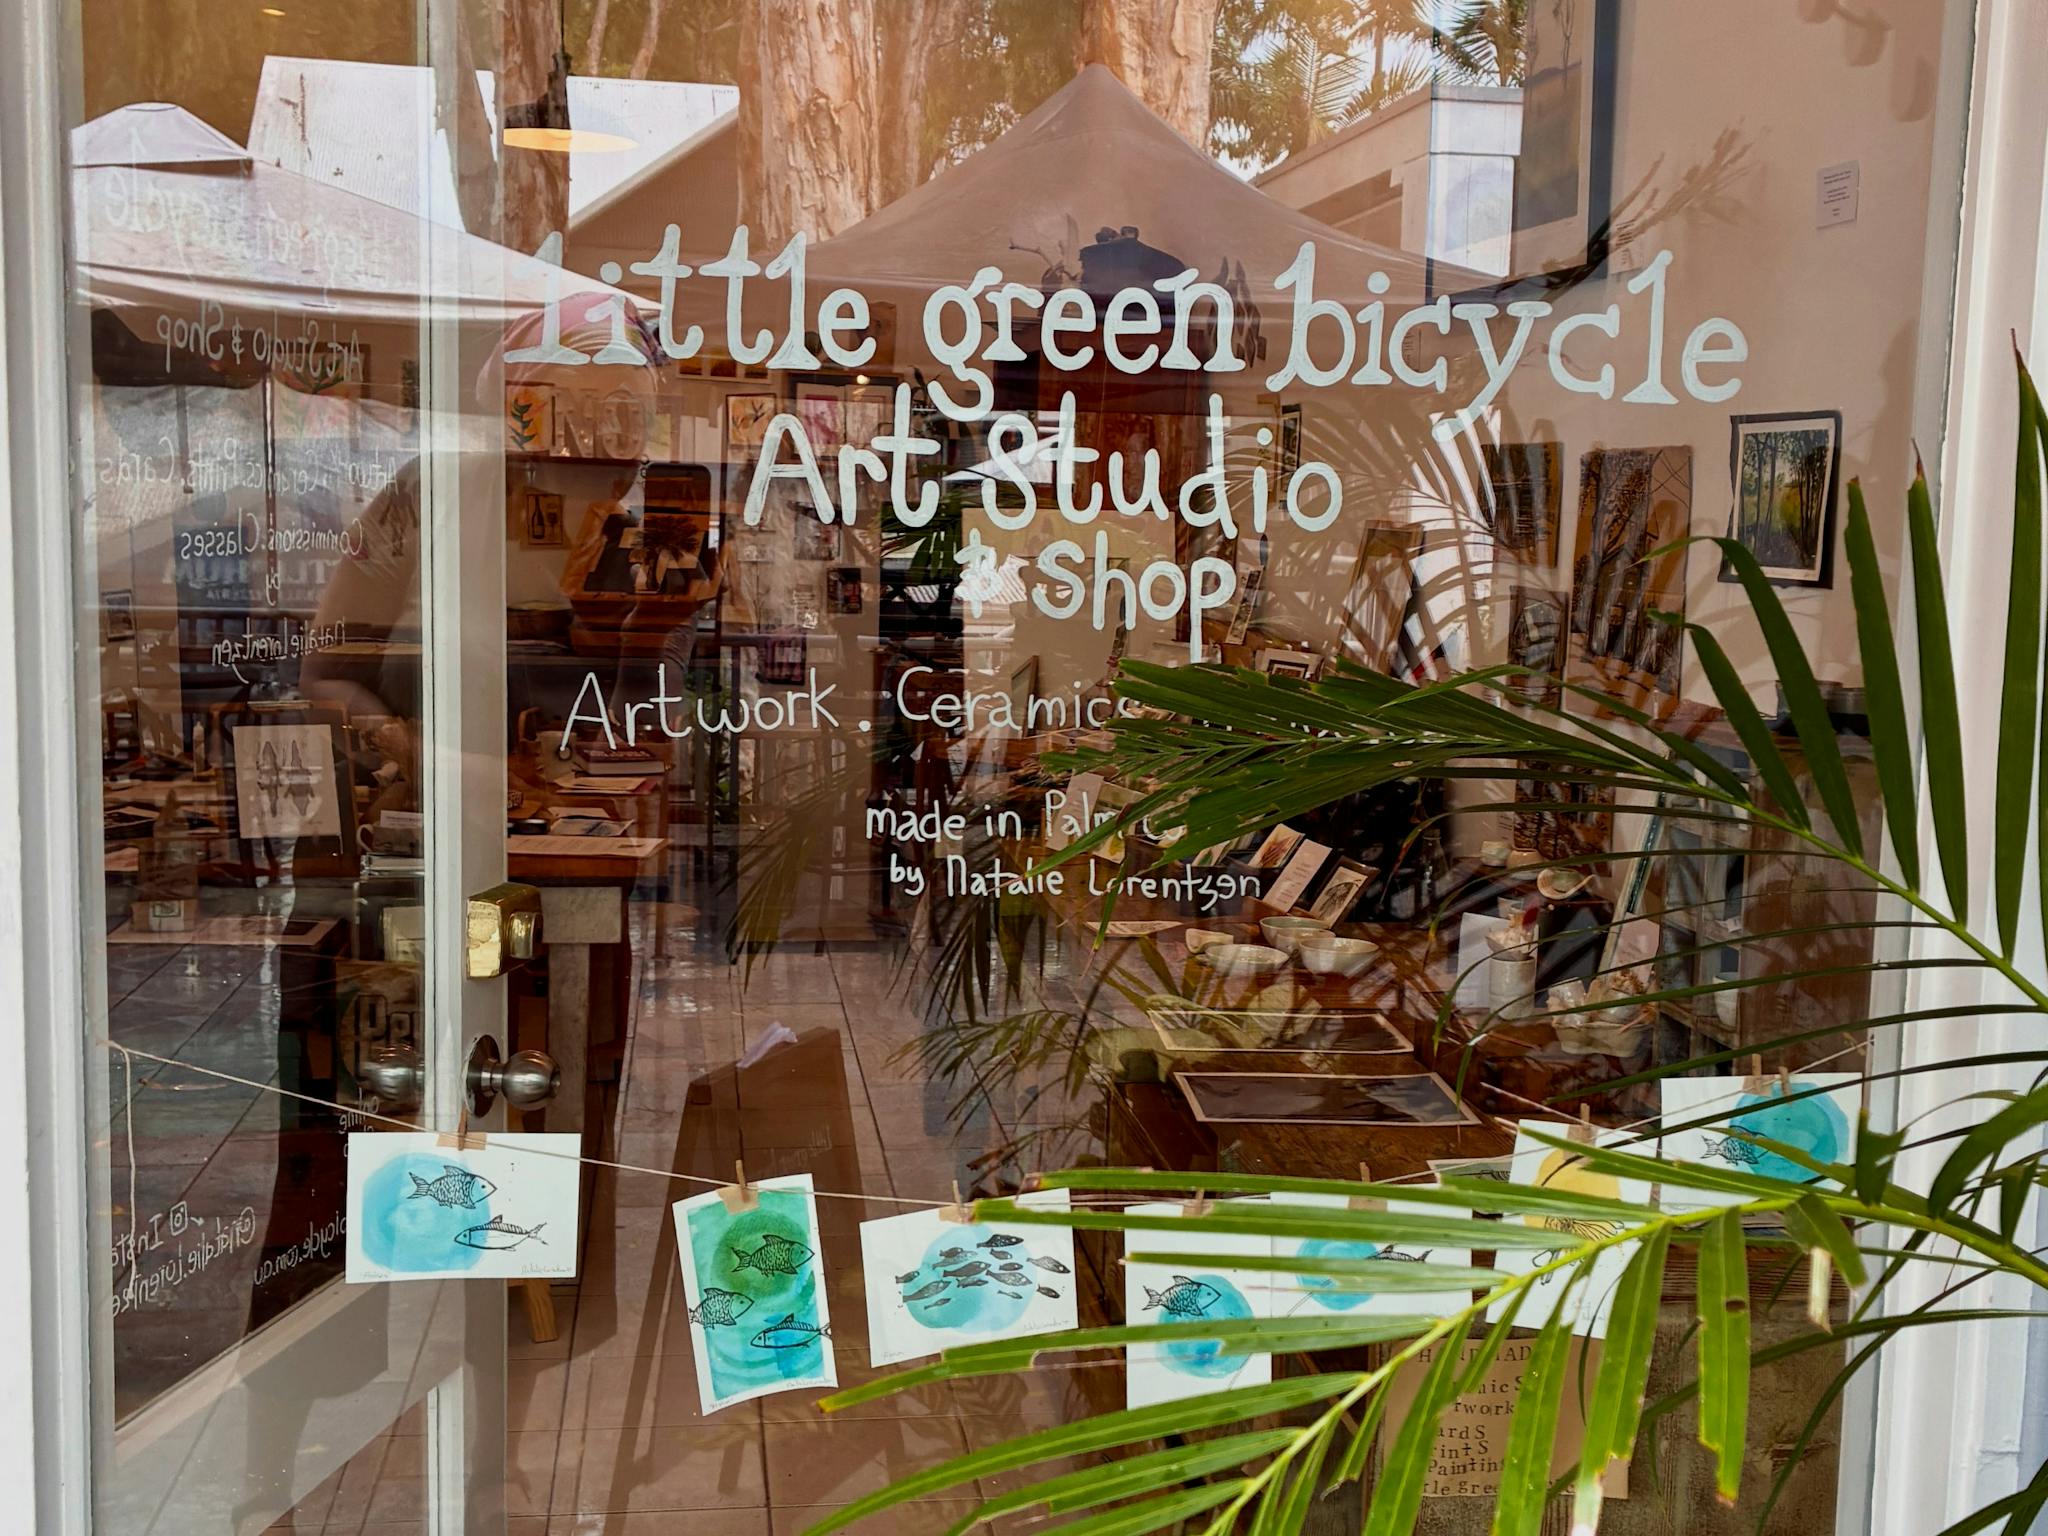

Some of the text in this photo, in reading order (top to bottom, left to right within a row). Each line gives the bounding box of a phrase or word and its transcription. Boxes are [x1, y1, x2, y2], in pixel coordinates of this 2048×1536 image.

[503, 223, 877, 371] little
[922, 265, 1247, 422] green
[1265, 240, 1749, 443] bicycle
[743, 381, 1344, 540] Art Studio
[866, 799, 967, 843] made
[984, 804, 1022, 842] in
[889, 852, 925, 897] by
[1088, 857, 1263, 912] Lorentzen
